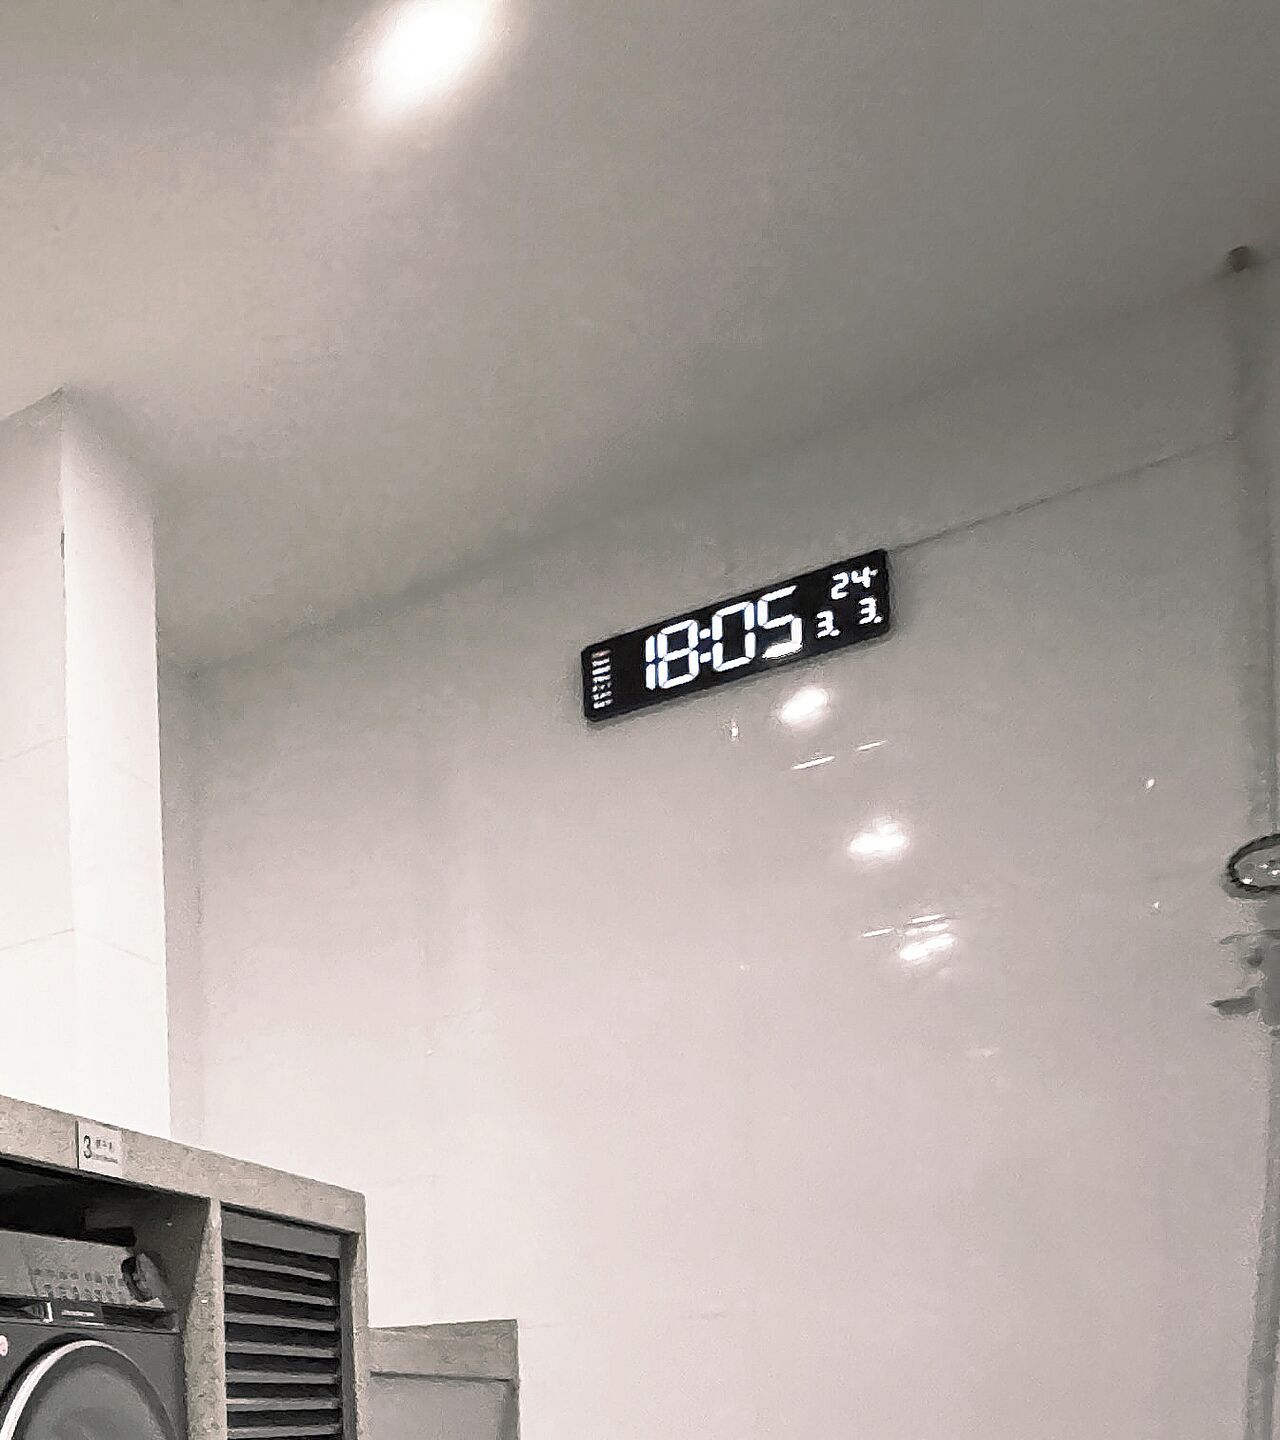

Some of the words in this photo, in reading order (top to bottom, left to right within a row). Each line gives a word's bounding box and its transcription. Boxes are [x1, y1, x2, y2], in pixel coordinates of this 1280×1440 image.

[830, 566, 878, 600] 24
[644, 585, 804, 692] 18:05
[83, 1134, 93, 1159] 3
